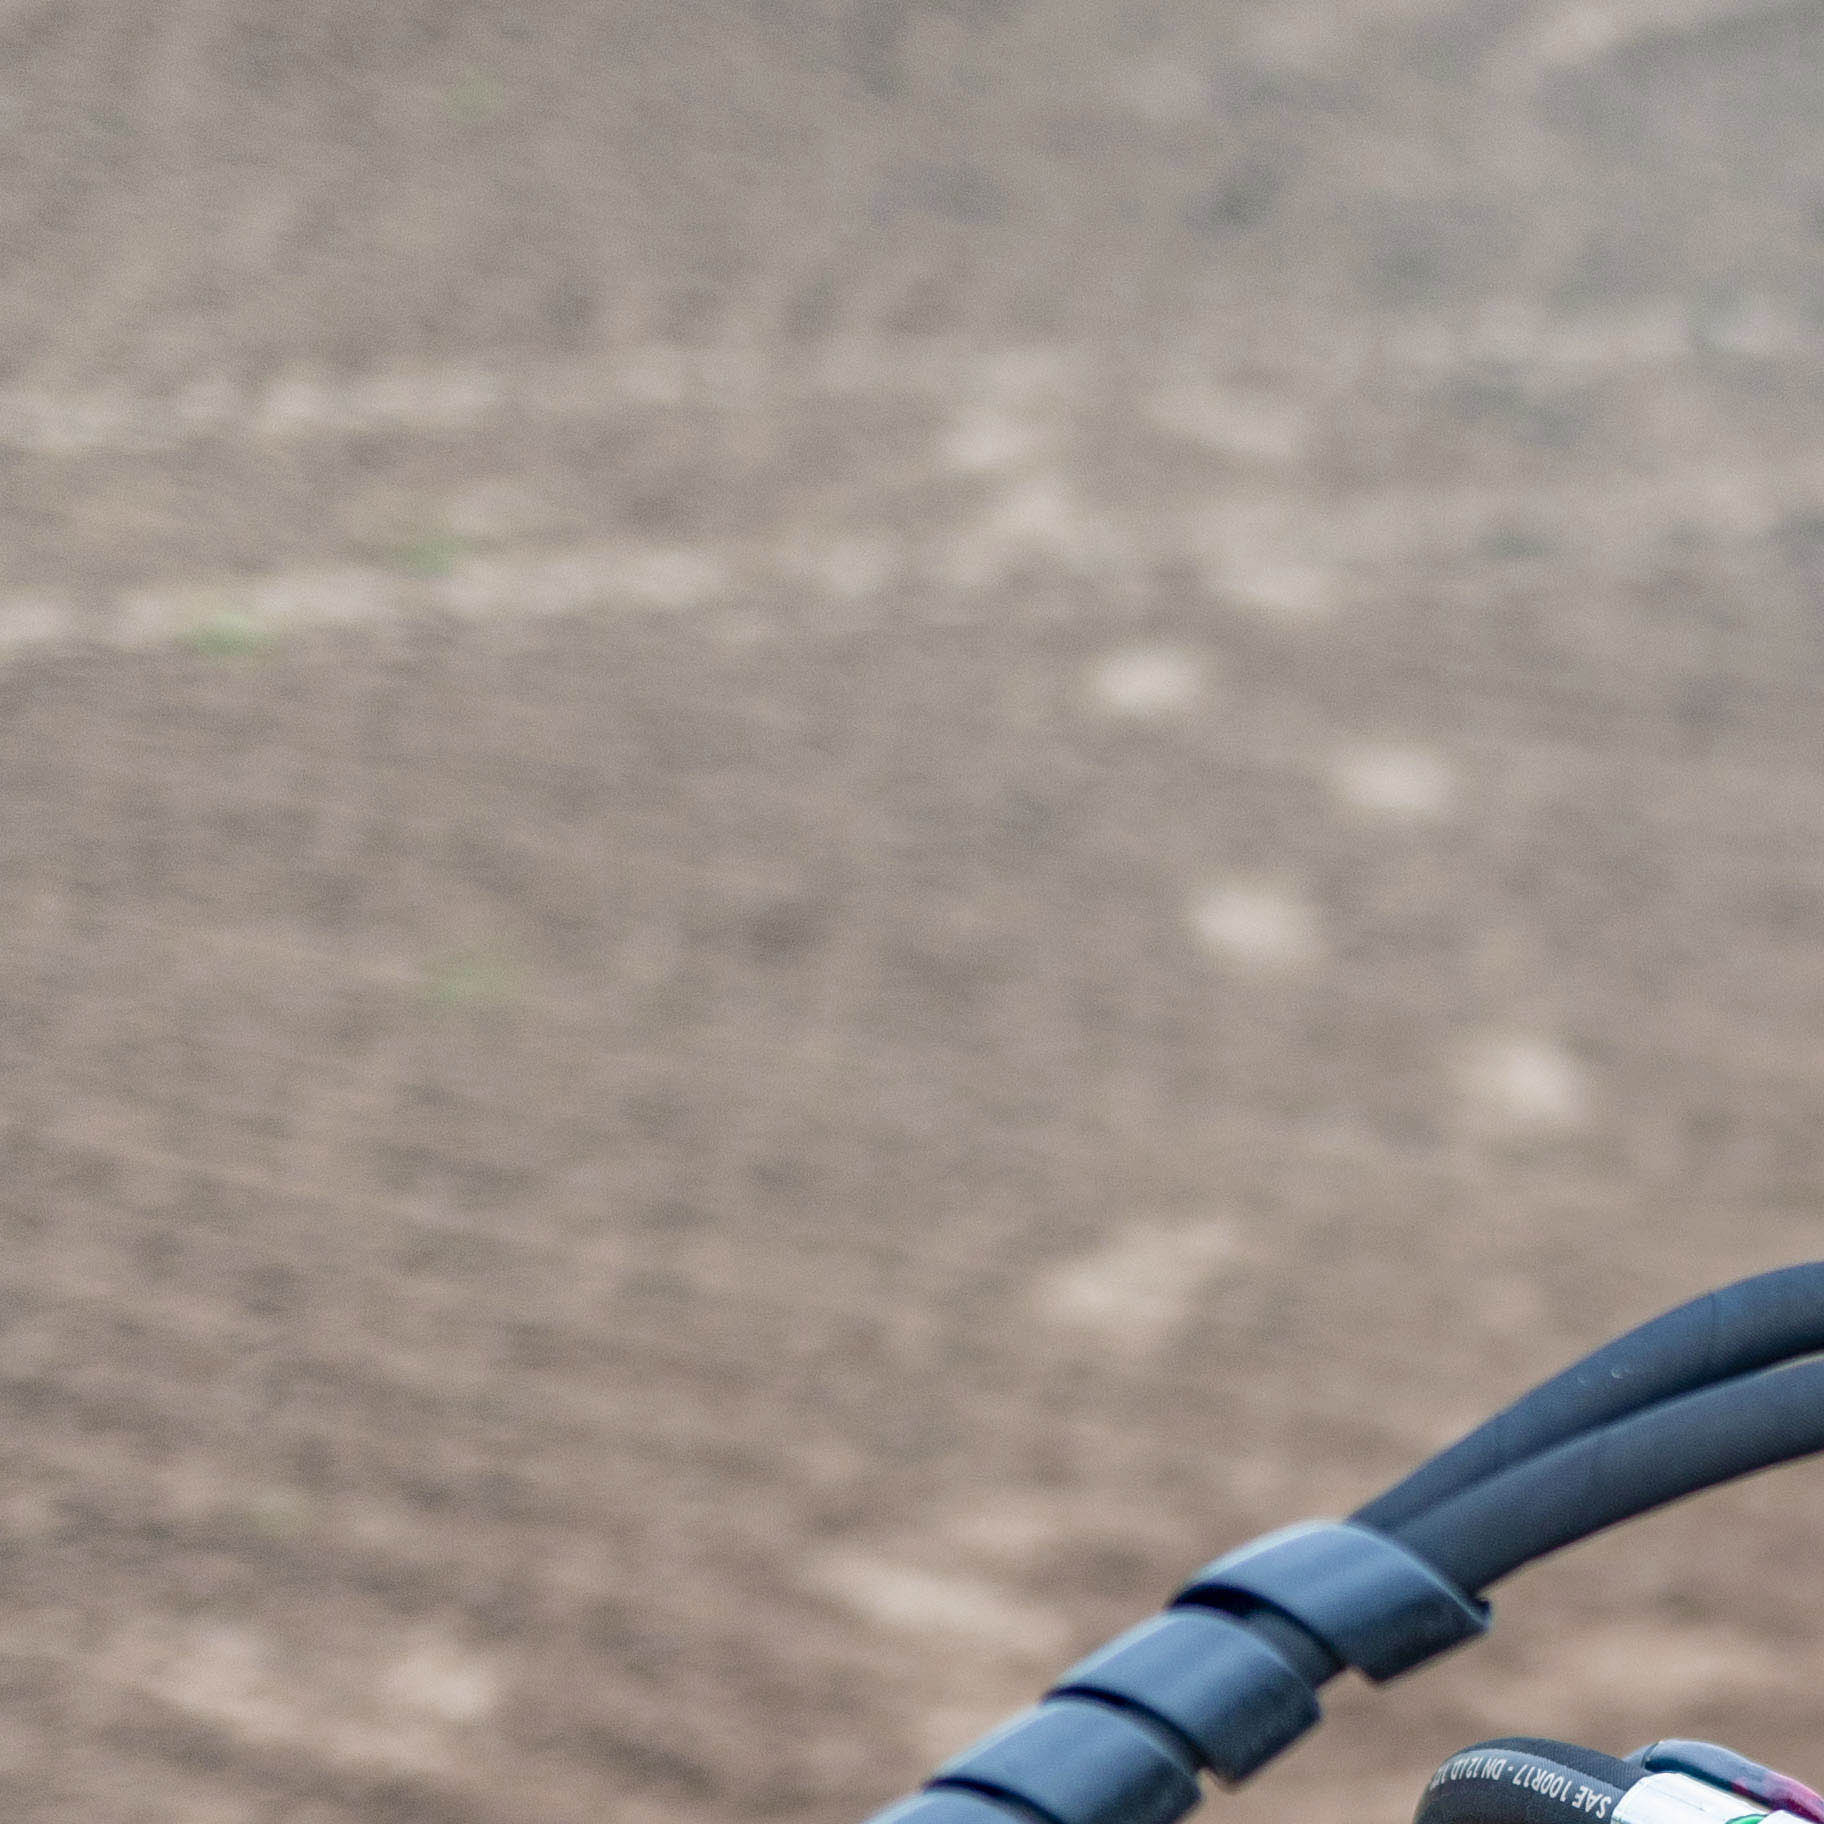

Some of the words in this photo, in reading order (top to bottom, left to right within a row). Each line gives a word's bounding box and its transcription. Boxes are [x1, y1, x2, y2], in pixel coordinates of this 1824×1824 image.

[1481, 1757, 1507, 1781] DN
[1512, 1764, 1573, 1802] 100R17
[1572, 1785, 1612, 1819] SAE
